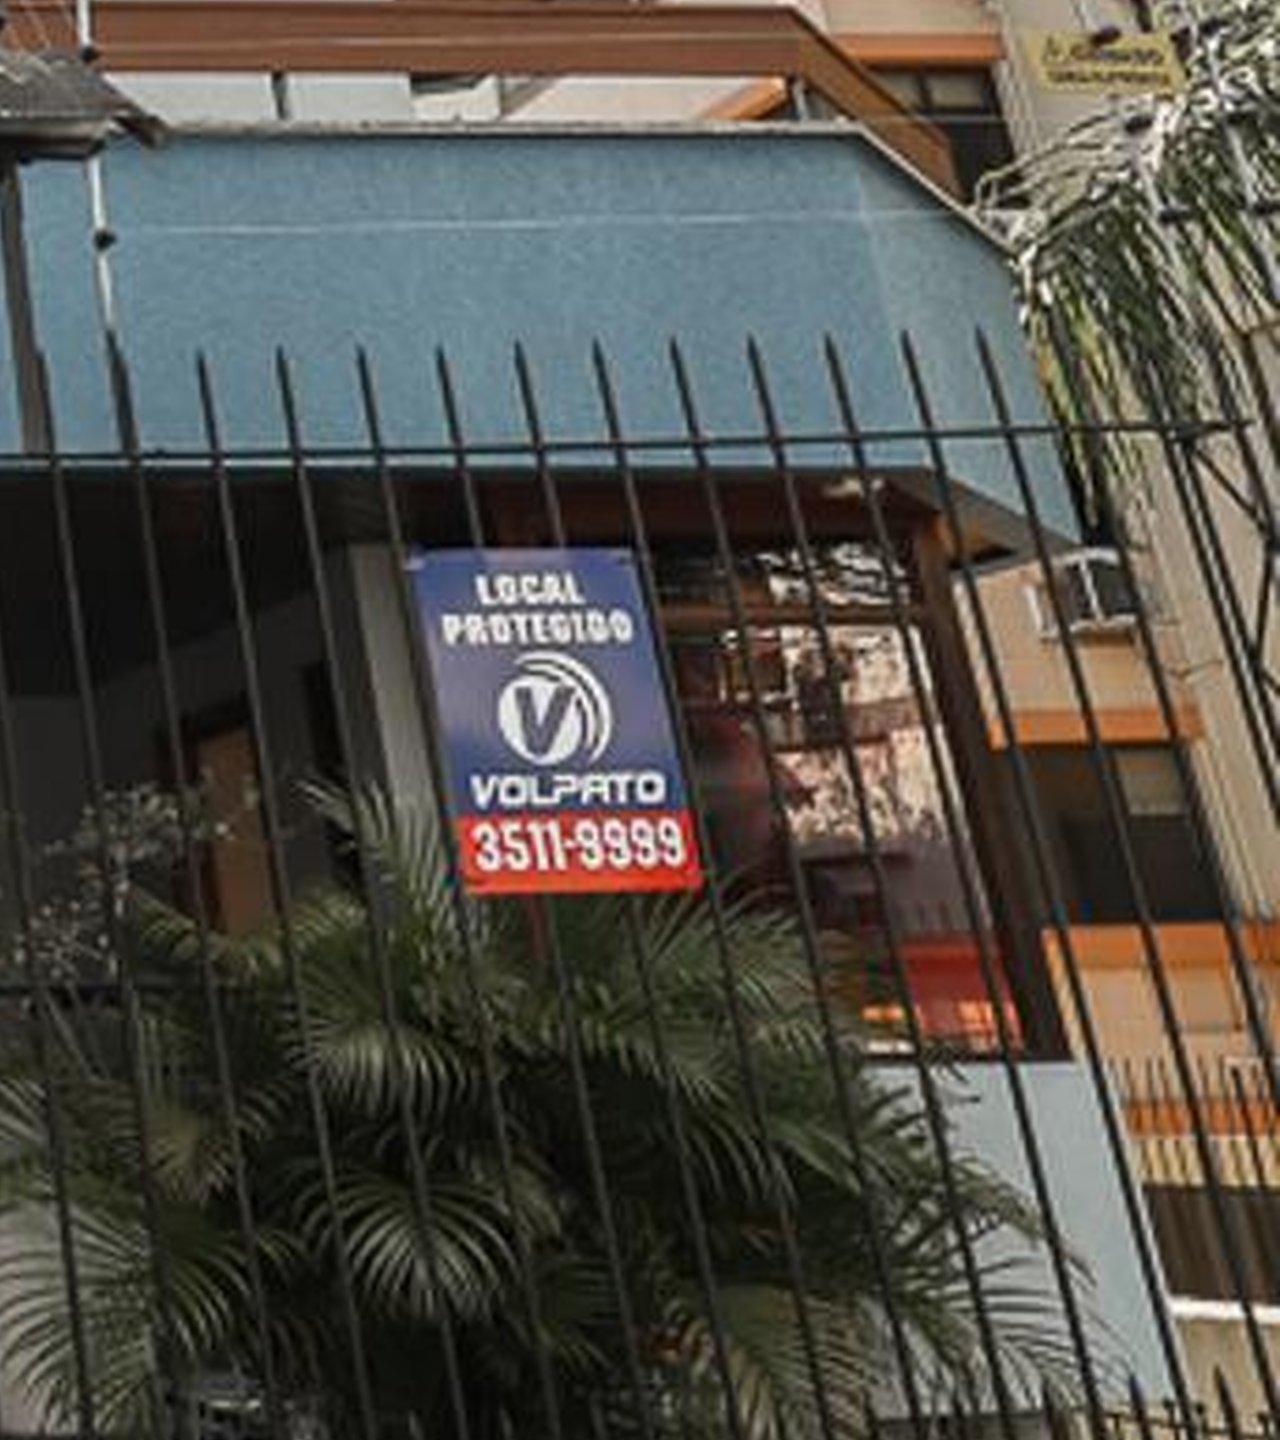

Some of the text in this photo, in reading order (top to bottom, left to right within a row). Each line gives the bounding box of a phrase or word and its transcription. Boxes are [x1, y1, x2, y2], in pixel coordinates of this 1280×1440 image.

[476, 571, 585, 605] LOCAL
[442, 609, 634, 645] PROTEGIDO
[470, 770, 666, 807] VOLPATO
[472, 819, 685, 872] 3511-9999
